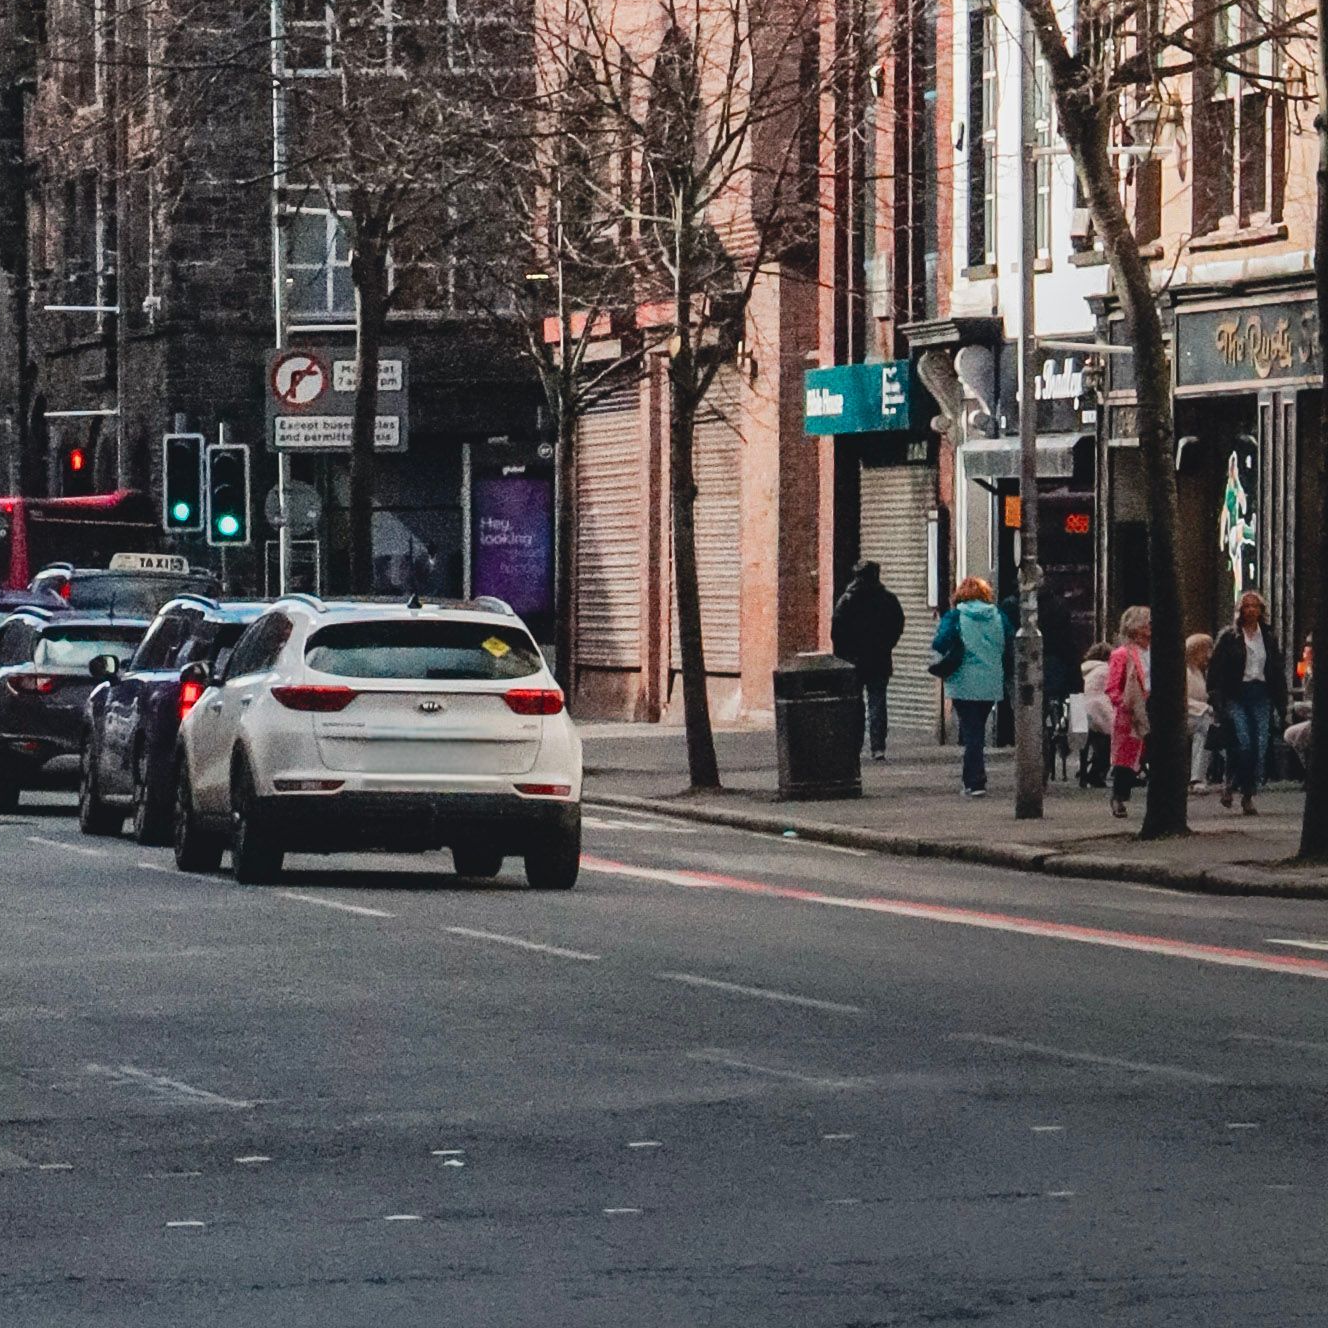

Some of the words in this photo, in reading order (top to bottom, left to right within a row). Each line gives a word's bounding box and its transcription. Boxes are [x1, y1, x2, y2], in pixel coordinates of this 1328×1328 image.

[1215, 316, 1245, 366] The
[1246, 315, 1292, 378] Rusty
[279, 420, 319, 431] Except
[279, 432, 301, 442] and
[303, 432, 354, 443] permitt
[139, 557, 169, 569] TAXI
